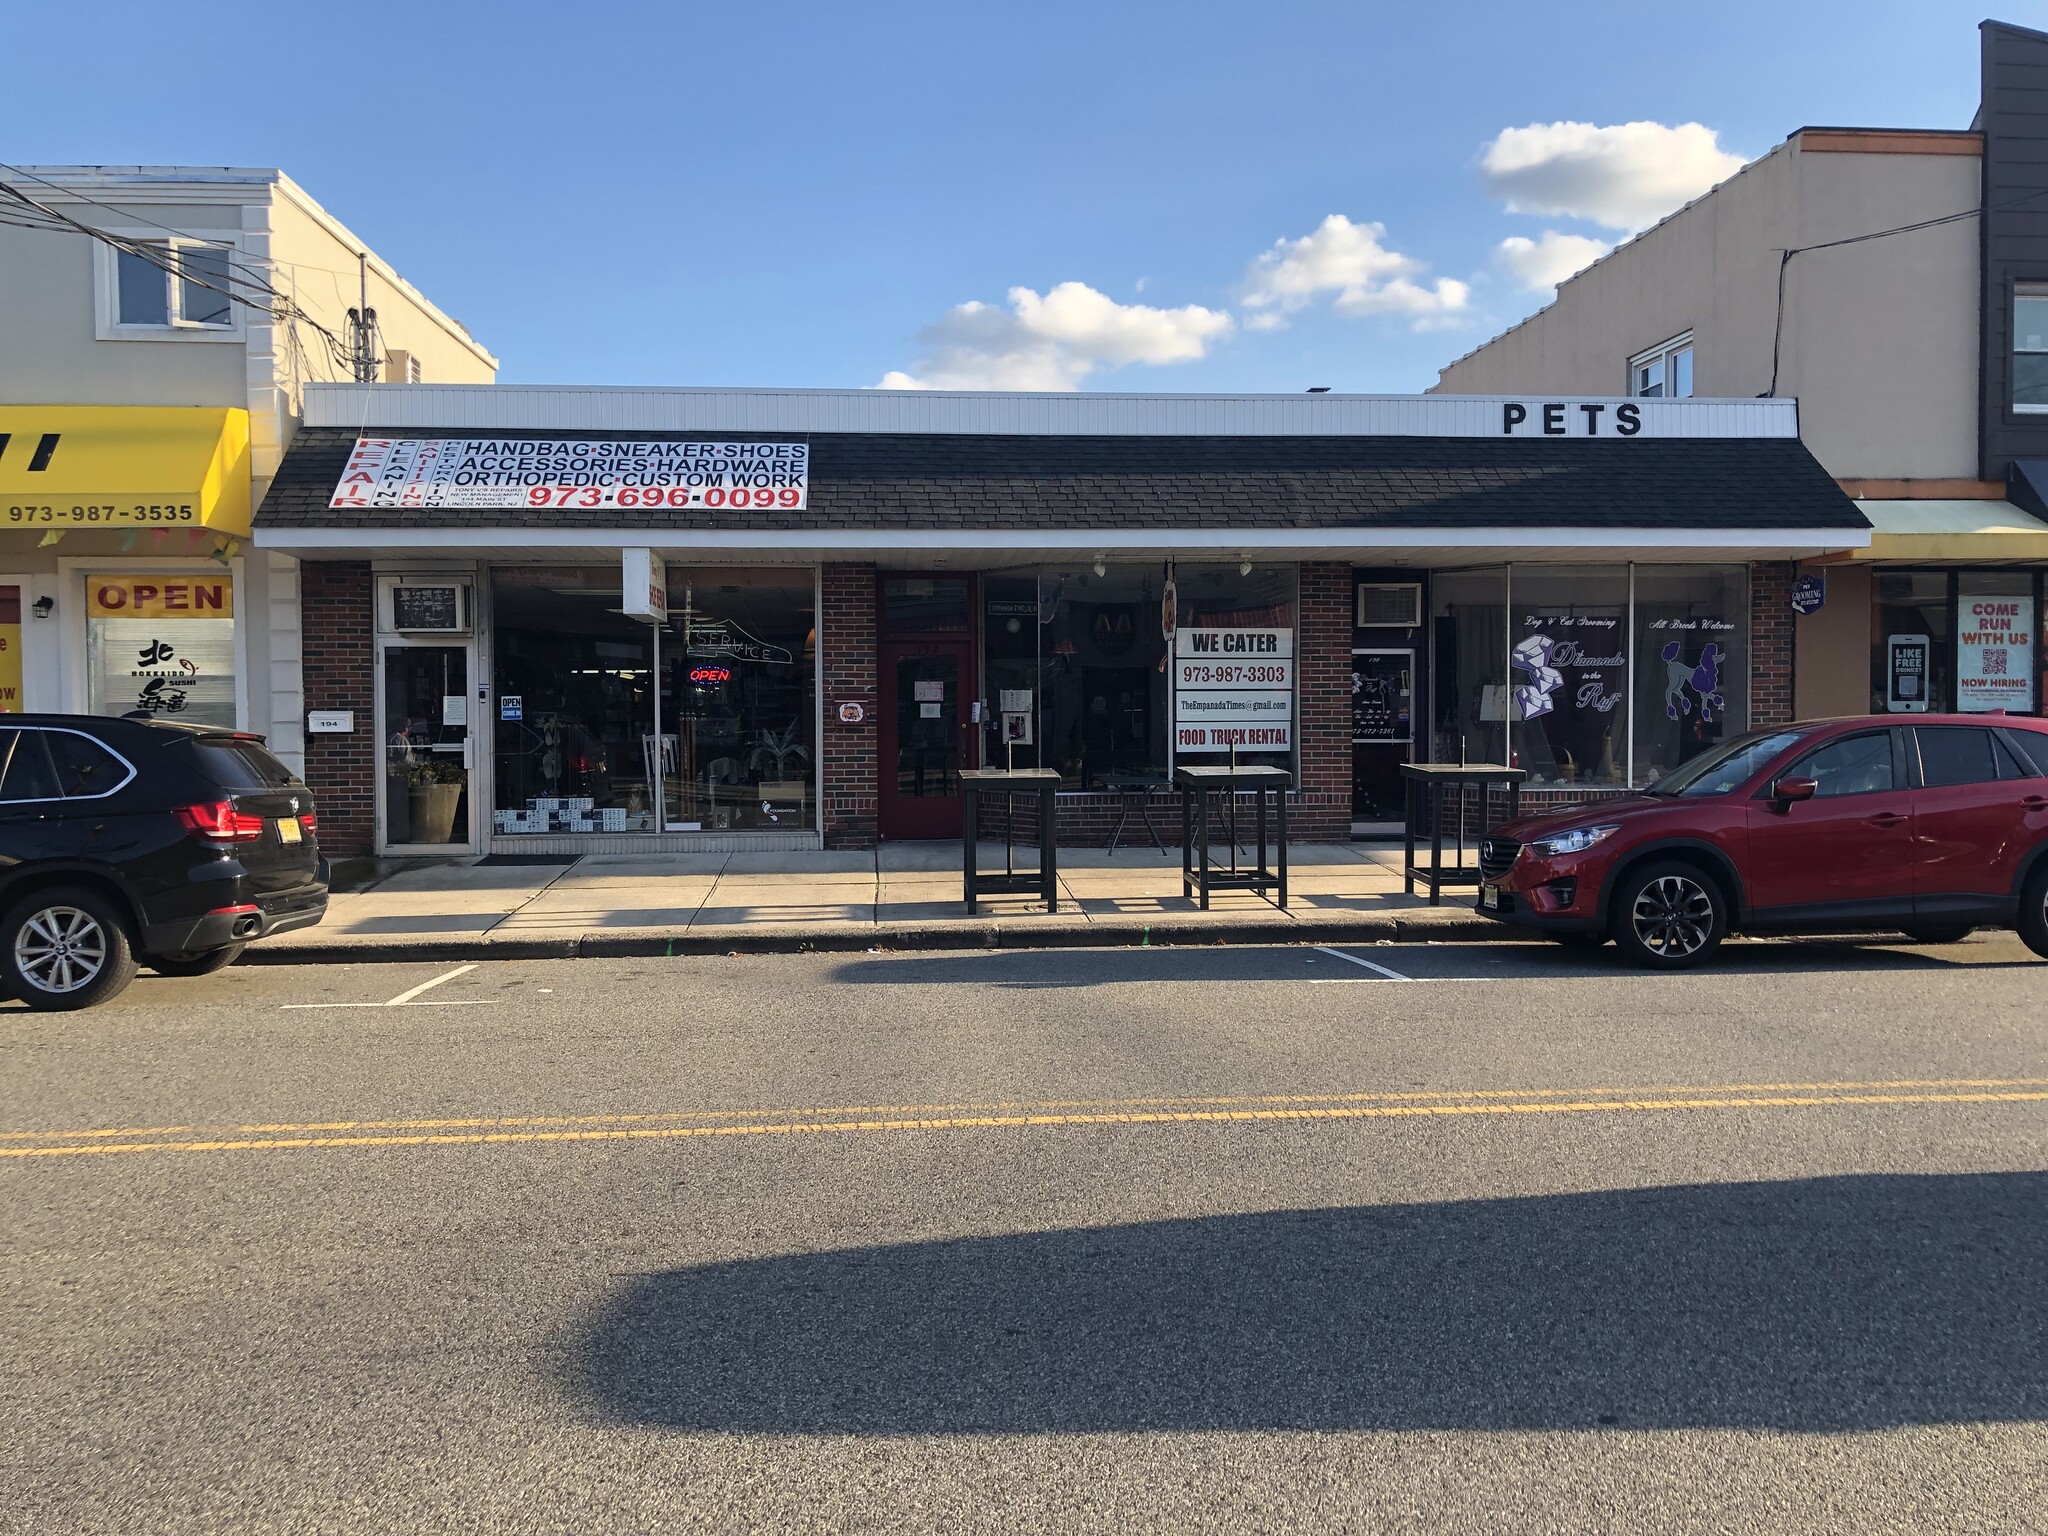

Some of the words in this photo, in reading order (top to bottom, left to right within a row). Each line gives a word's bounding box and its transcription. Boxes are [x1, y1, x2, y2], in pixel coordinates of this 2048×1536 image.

[1503, 403, 1641, 436] PETS
[464, 441, 590, 457] HANDBAG
[597, 443, 717, 457] SNEAKER
[723, 444, 806, 458] SHOES
[333, 440, 391, 506] REPAIR
[459, 457, 648, 472] ACCESSORIES
[657, 458, 805, 473] HARDWARE
[373, 441, 417, 507] CLEANING
[400, 441, 445, 507] SANITIZING
[425, 441, 462, 507] RESTORATION
[454, 471, 615, 487] ORTHOPEDIC
[622, 473, 723, 488] CUSTOM
[732, 474, 805, 488] WORK
[528, 485, 801, 508] 973-696-0099
[9, 505, 192, 522] 973-987-3535
[97, 585, 223, 610] OPEN
[1972, 603, 2019, 616] COME
[1524, 615, 1542, 628] Dog
[1560, 616, 1574, 626] Cat
[1577, 617, 1617, 629] Grooming
[1649, 619, 1668, 629] All
[1669, 619, 1697, 629] Breeds
[1701, 619, 1735, 630] Welcome
[1979, 618, 2012, 630] RUN
[696, 632, 771, 660] SERVICE
[1192, 633, 1219, 652] WE
[1223, 633, 1277, 653] CATER
[1962, 632, 2004, 645] WITH
[2008, 632, 2028, 645] US
[137, 639, 175, 668] 北
[1550, 640, 1626, 668] Diamonds
[1895, 648, 1922, 659] LIKE
[1895, 659, 1922, 668] FREE
[690, 670, 730, 681] OPEN
[1183, 666, 1285, 683] 973-987-3303
[1961, 679, 1988, 688] NOW
[1990, 679, 2027, 688] HIRING
[503, 698, 521, 707] OPEN
[1181, 700, 1287, 711] TheEmpanadaTimes@gmail.com
[1576, 682, 1622, 712] Ruff
[1179, 729, 1206, 745] FOOD
[1210, 729, 1247, 745] TRUCK
[1249, 729, 1287, 744] RENTAL
